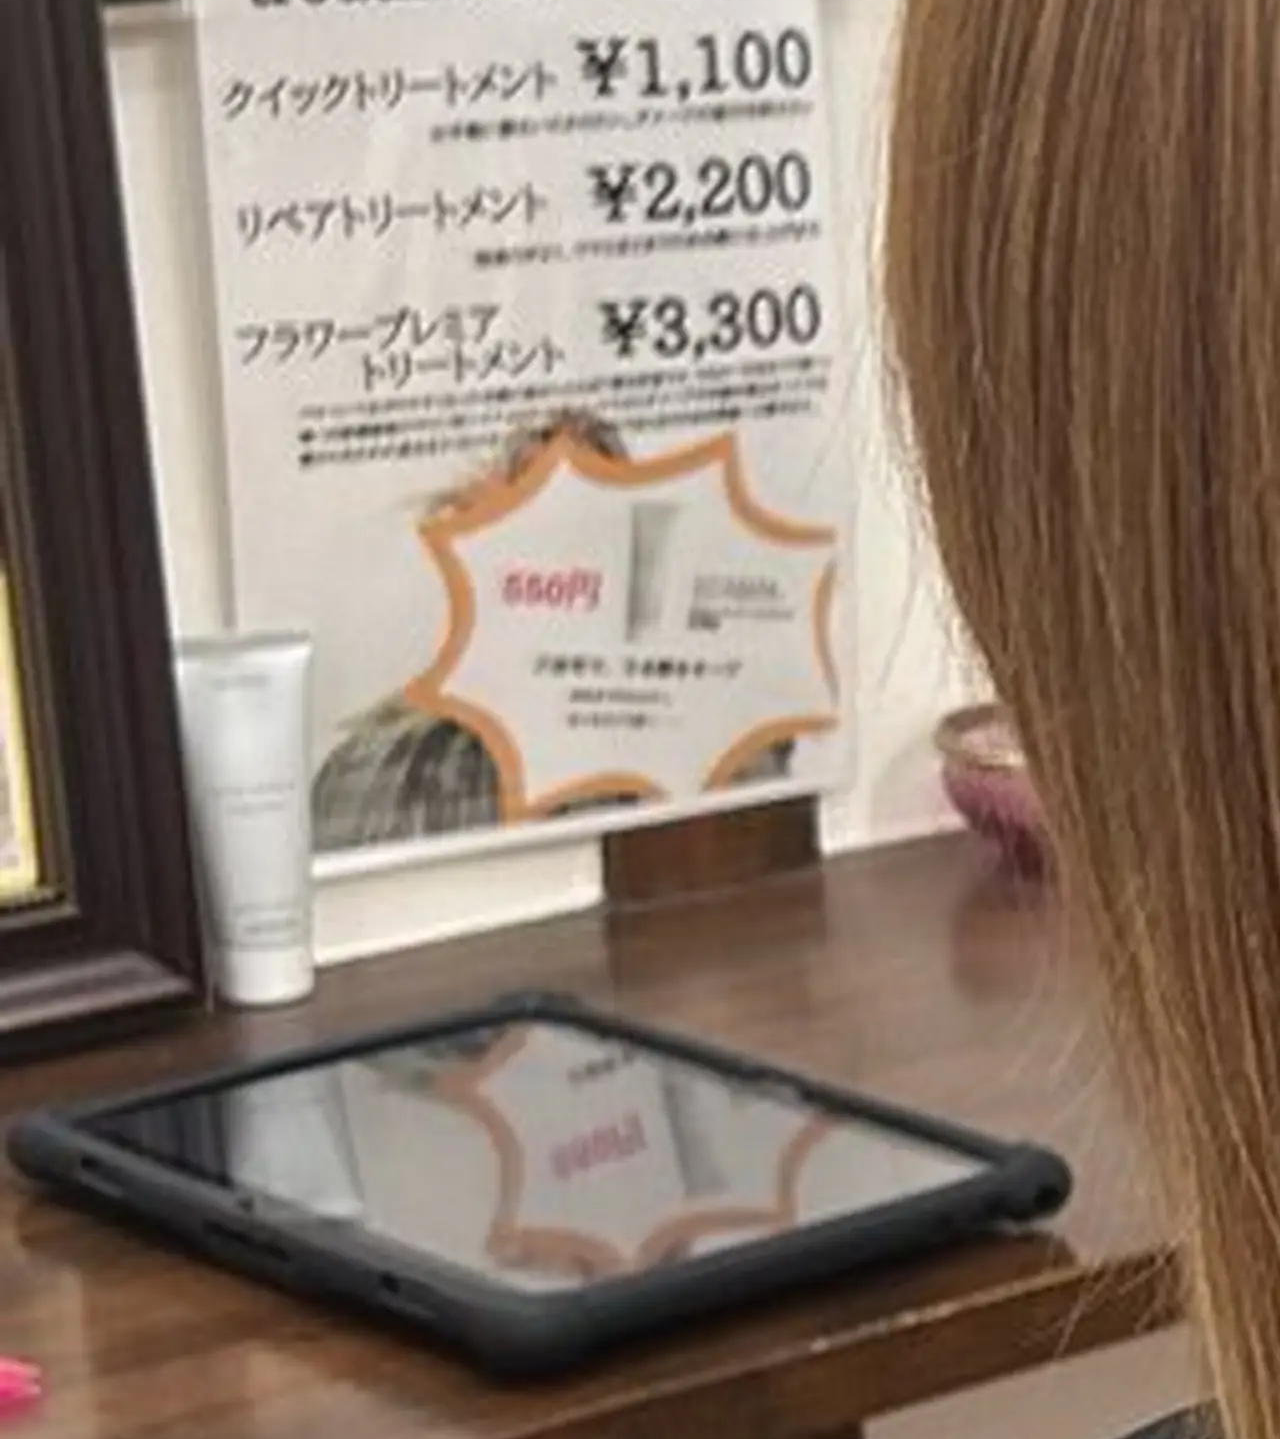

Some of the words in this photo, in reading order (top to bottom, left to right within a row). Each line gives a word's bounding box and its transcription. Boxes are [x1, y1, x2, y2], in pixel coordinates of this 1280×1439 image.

[223, 60, 557, 118] クイックトリートメント
[575, 28, 812, 102] ¥1,100
[235, 183, 546, 245] リペアトリートメント
[588, 152, 812, 226] ¥2,200
[235, 303, 498, 363] フラワープレミア
[598, 284, 822, 359] ¥3,300
[362, 340, 563, 390] トリートメント
